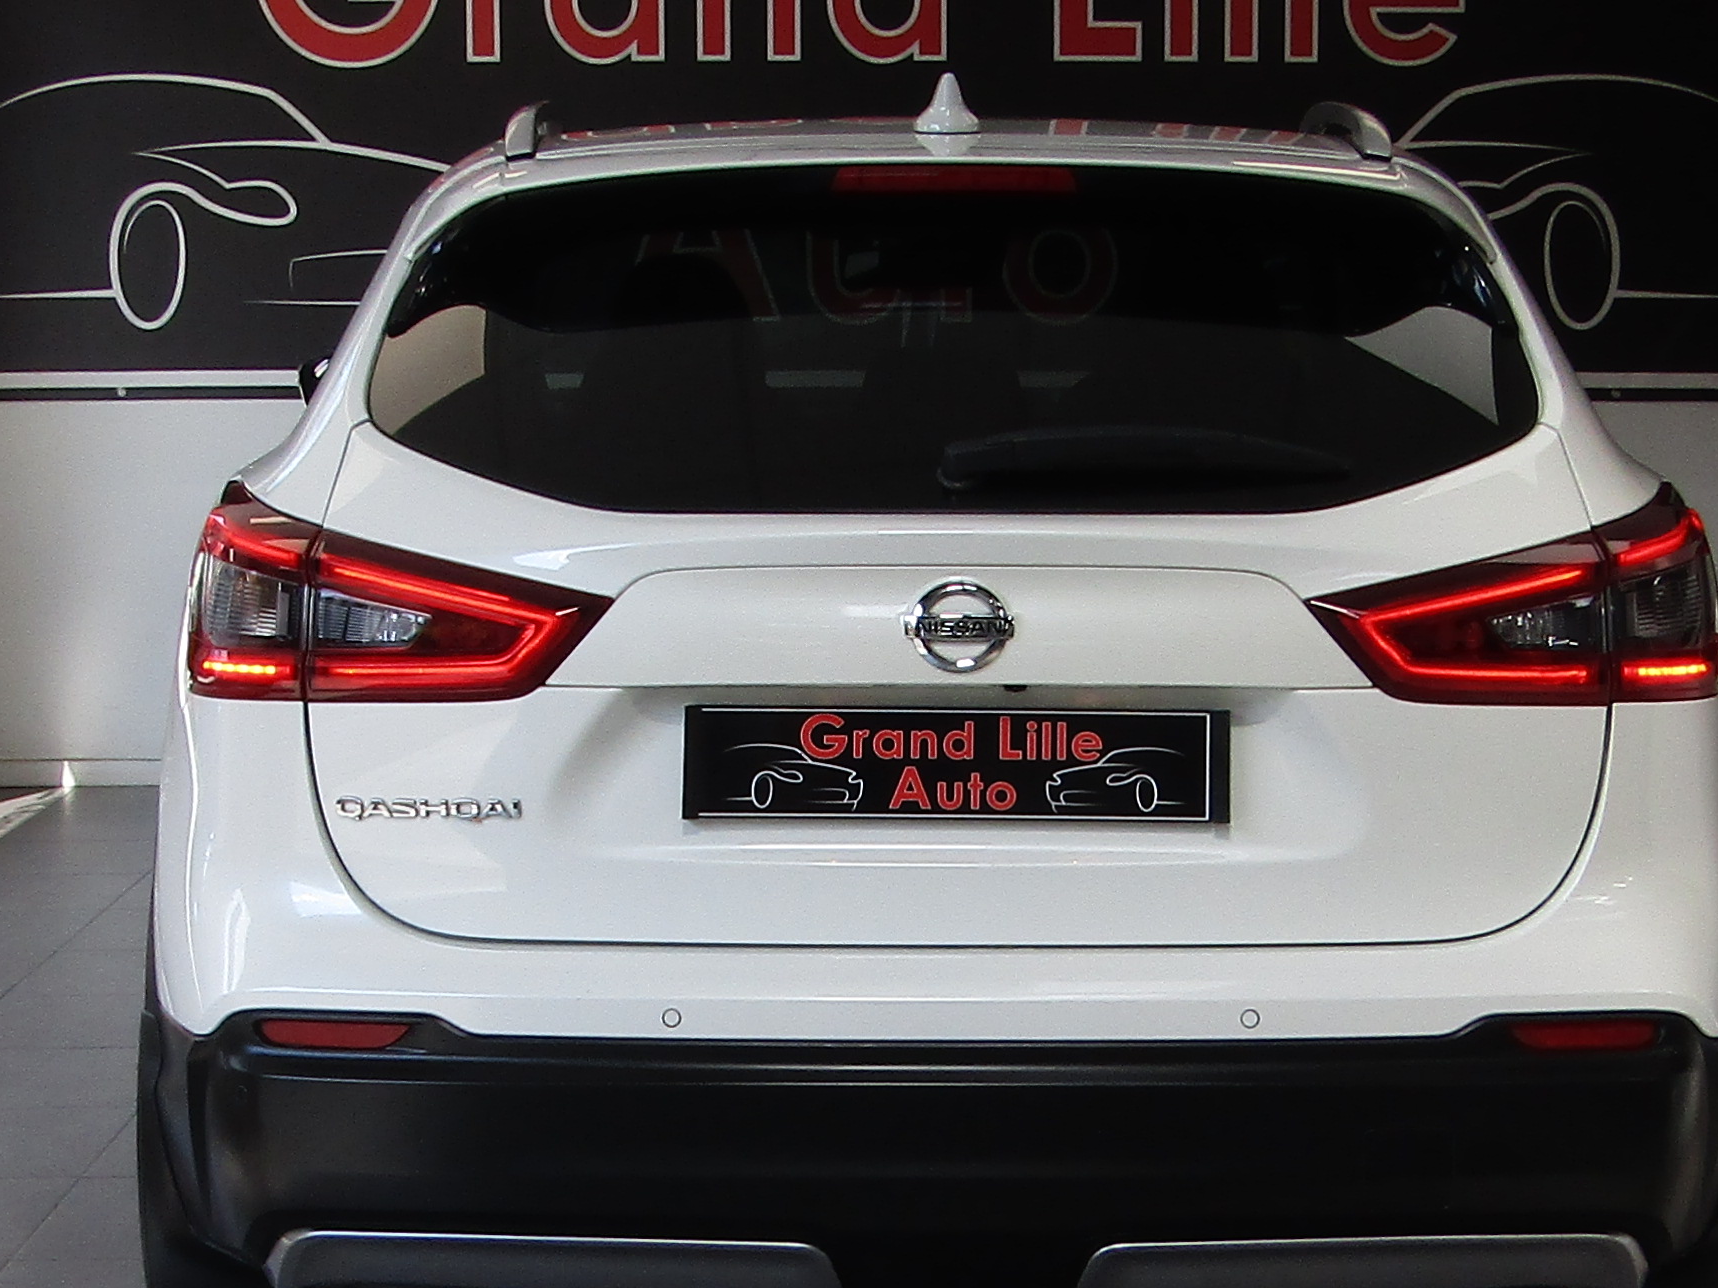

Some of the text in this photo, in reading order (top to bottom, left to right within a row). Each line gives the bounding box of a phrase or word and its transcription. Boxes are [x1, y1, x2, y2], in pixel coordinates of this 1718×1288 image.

[911, 618, 1010, 638] NISSAN
[800, 713, 1103, 762] Grand Lille
[888, 766, 1017, 811] Auto
[336, 795, 522, 821] QASHQAI
